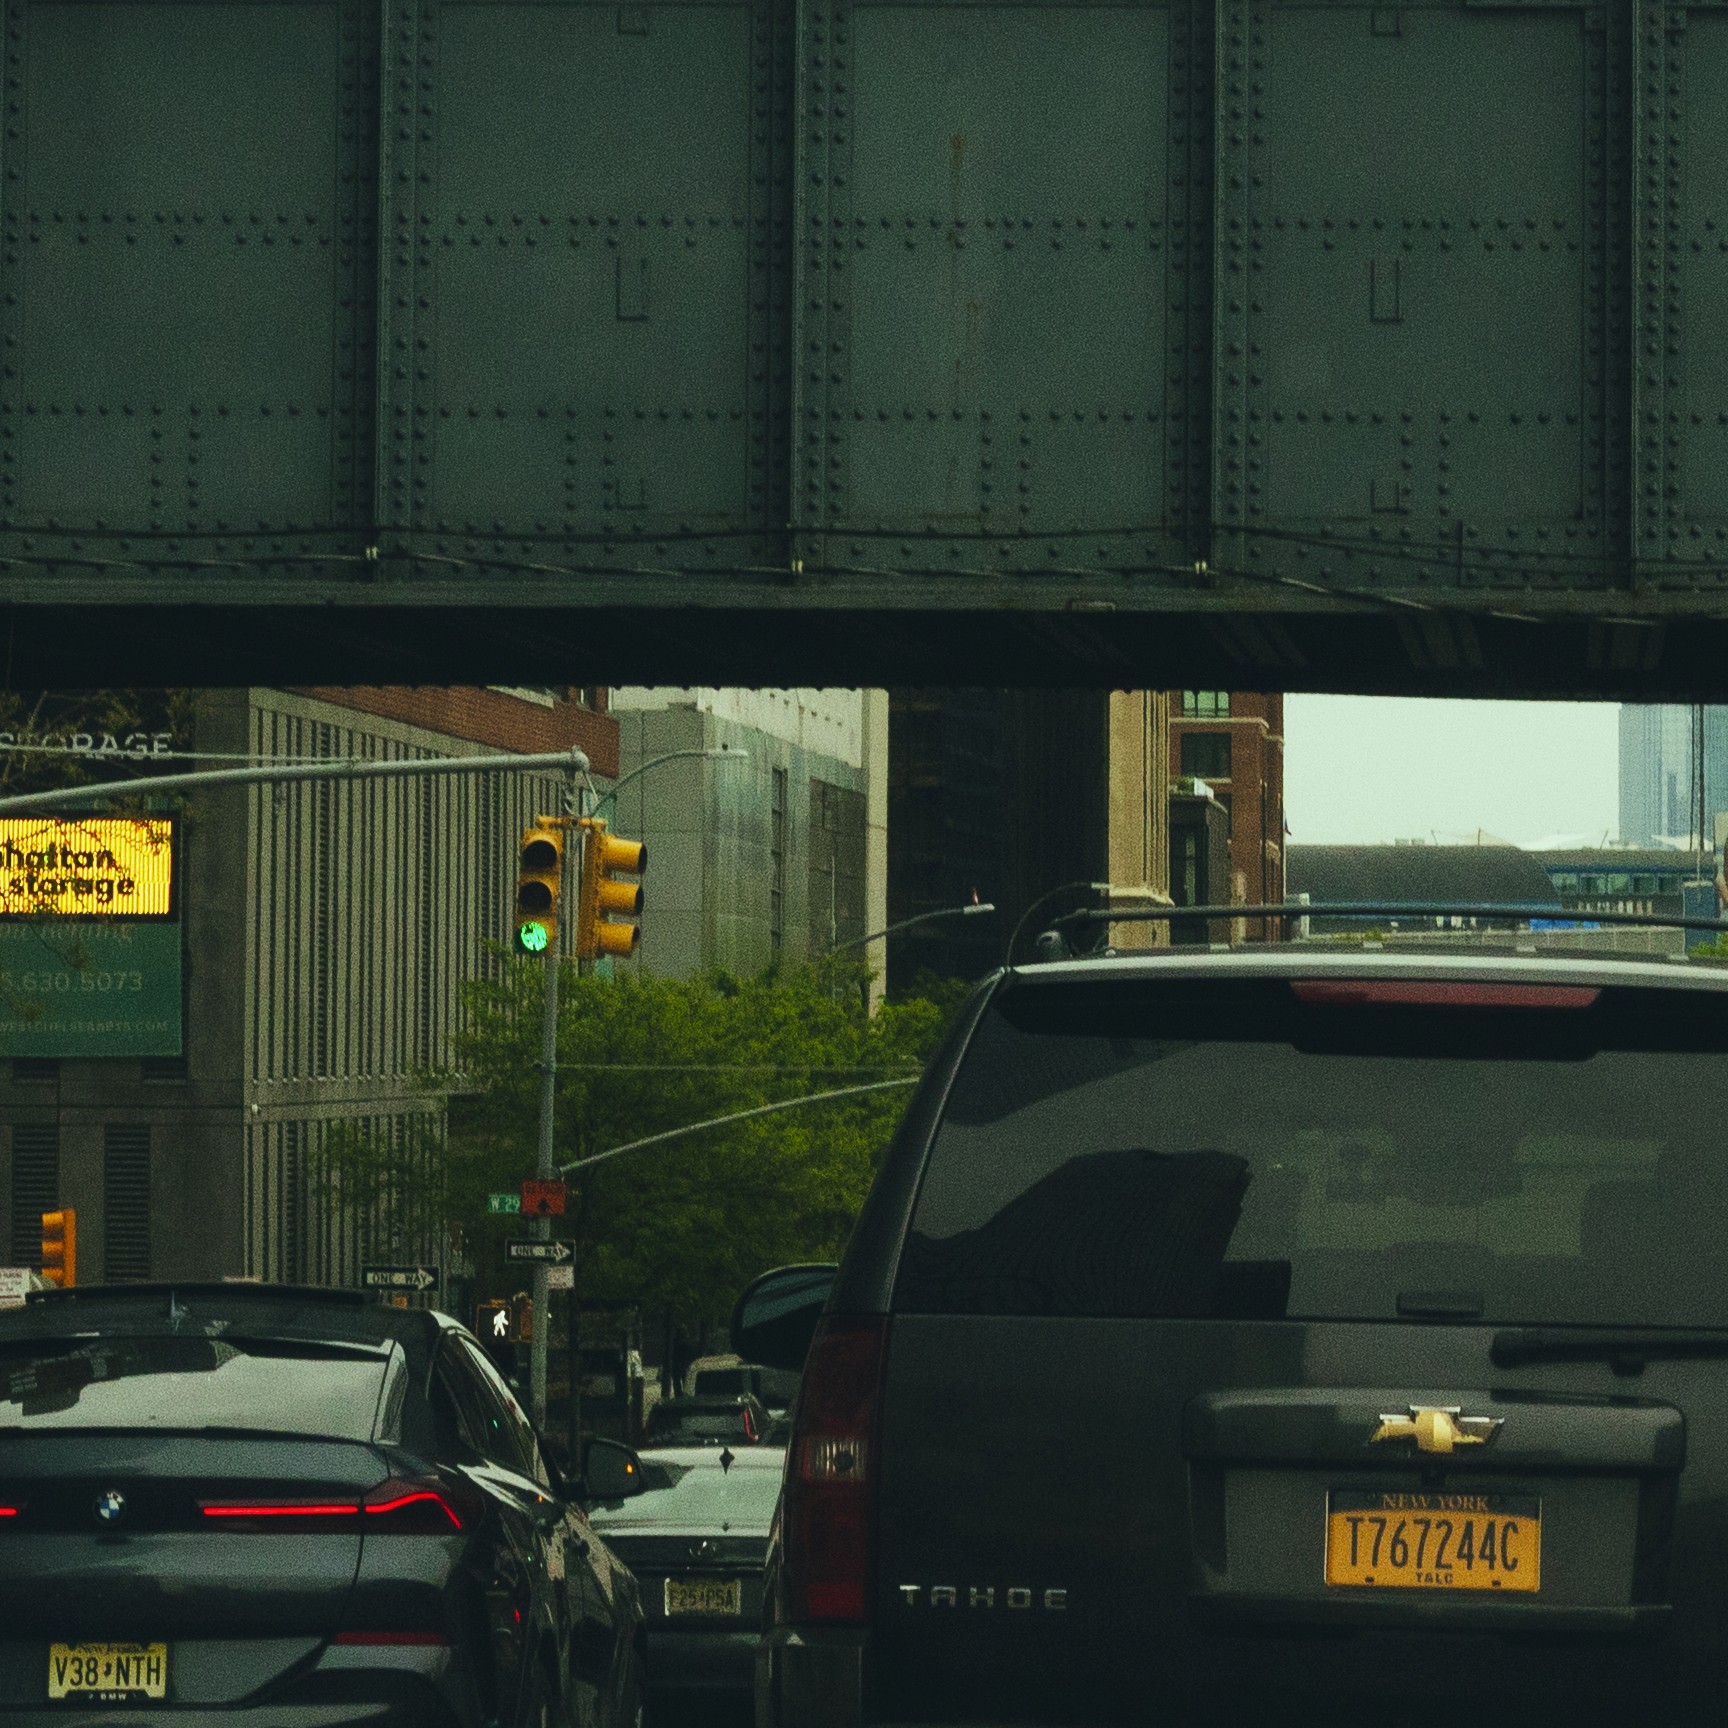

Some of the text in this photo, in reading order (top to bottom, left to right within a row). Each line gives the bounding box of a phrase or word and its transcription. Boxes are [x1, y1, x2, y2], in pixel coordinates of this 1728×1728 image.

[1382, 1494, 1489, 1511] NEW YORK
[1346, 1517, 1519, 1571] T767244C
[899, 1584, 1068, 1610] TAHOE
